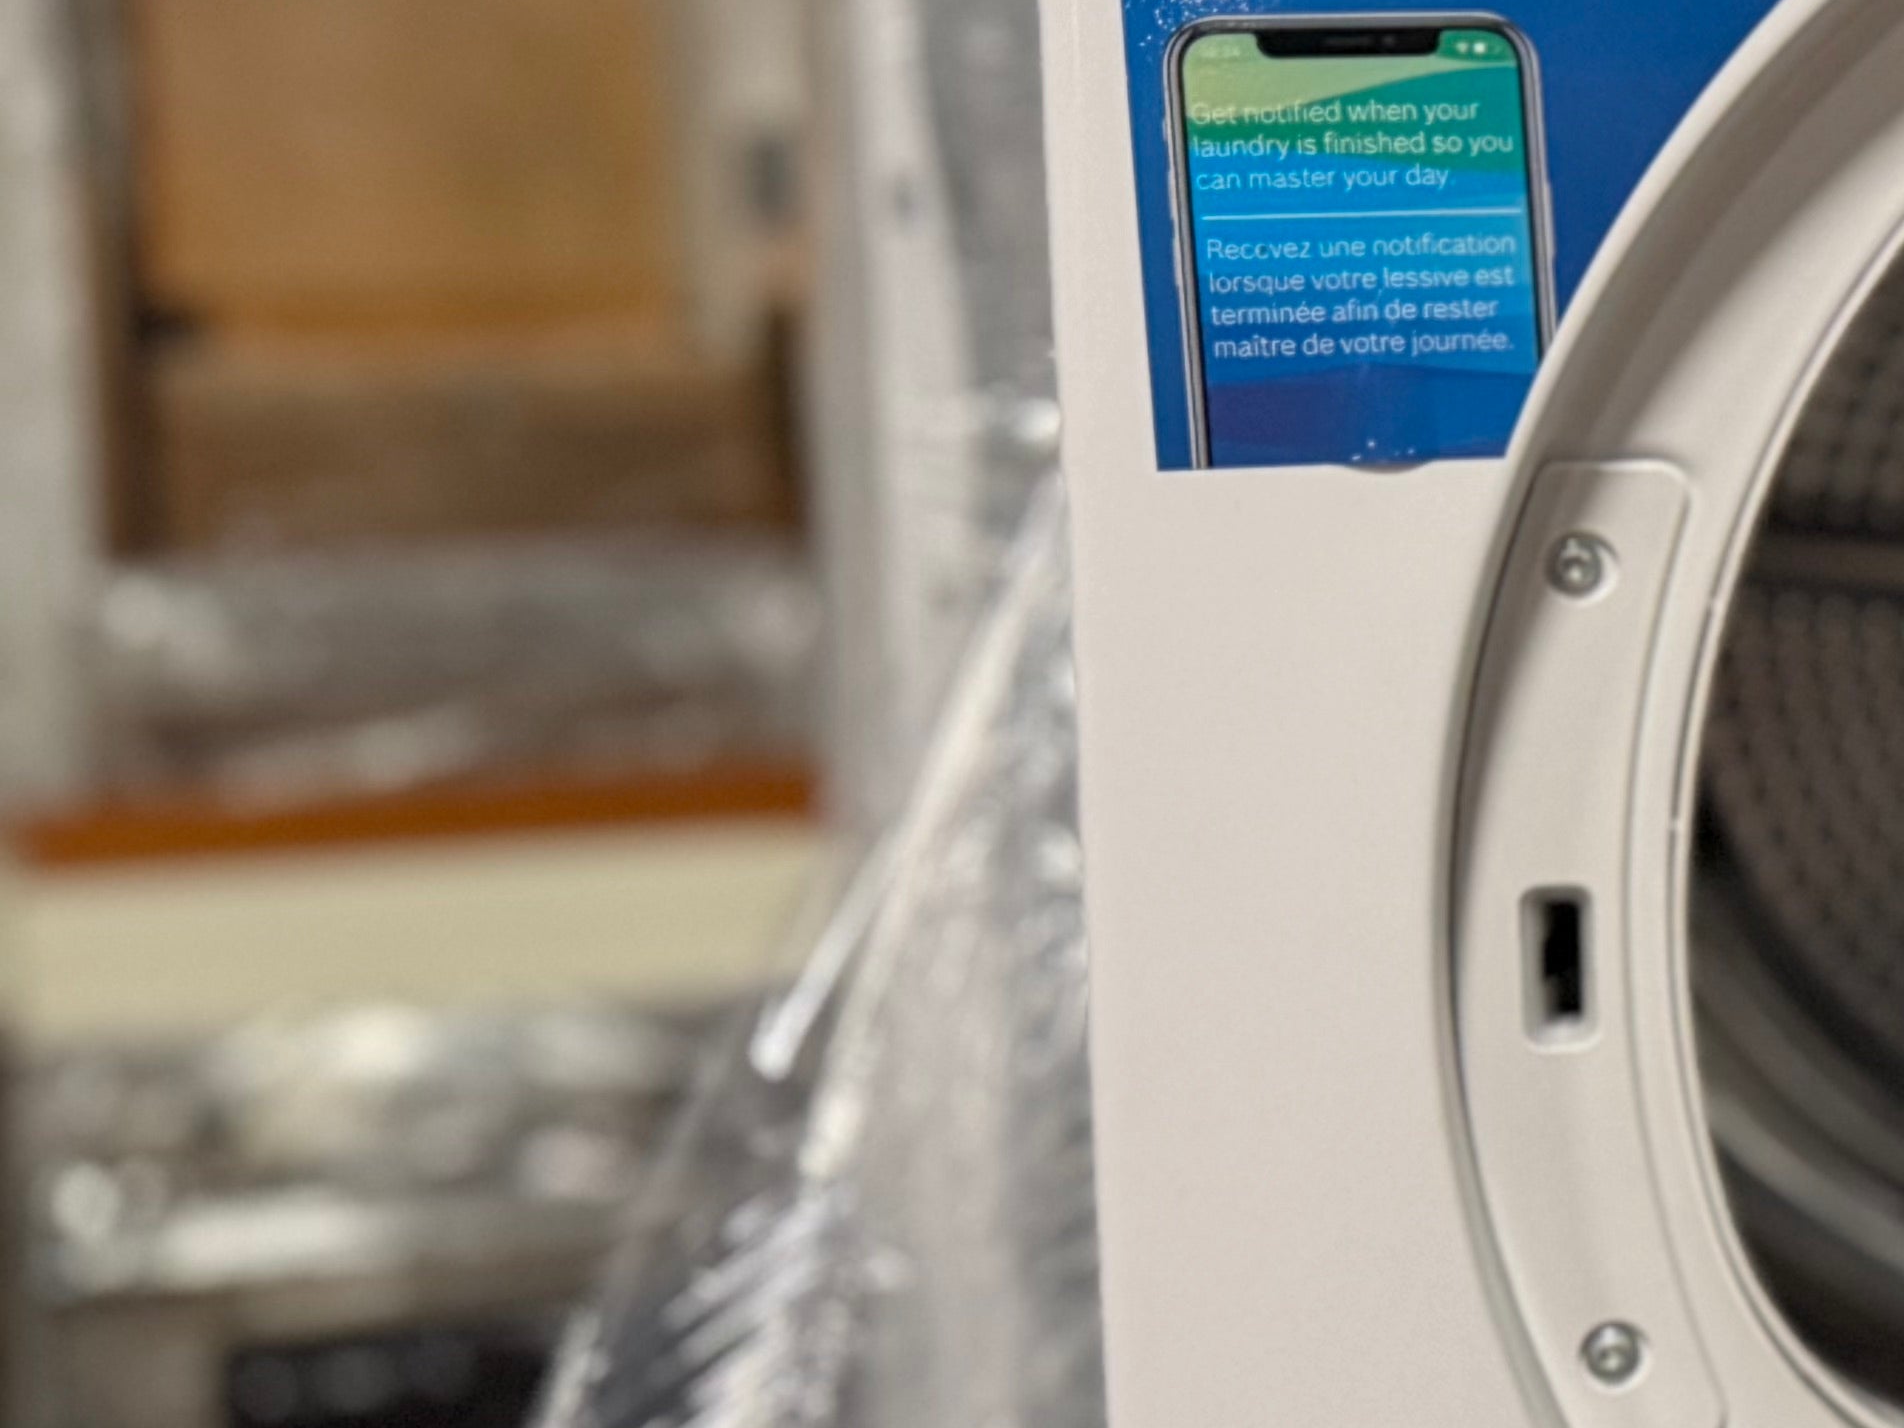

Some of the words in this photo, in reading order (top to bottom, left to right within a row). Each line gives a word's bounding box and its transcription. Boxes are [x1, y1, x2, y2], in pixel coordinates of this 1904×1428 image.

[1192, 103, 1238, 124] Get
[1243, 99, 1340, 123] notified
[1347, 100, 1417, 121] when
[1423, 102, 1479, 124] your
[1192, 135, 1289, 160] laundry
[1298, 134, 1317, 154] is
[1323, 131, 1425, 155] finished
[1432, 135, 1462, 153] so
[1468, 134, 1513, 156] you
[1196, 173, 1240, 190] can
[1249, 167, 1335, 188] master
[1342, 171, 1398, 191] your
[1319, 240, 1366, 258] une
[1372, 232, 1516, 256] notification
[1209, 274, 1304, 295] lorsque
[1311, 271, 1377, 291] votre
[1383, 267, 1468, 289] lessive
[1475, 266, 1515, 287] est
[1211, 303, 1326, 326] terminée
[1332, 300, 1378, 323] afin
[1384, 299, 1417, 321] de
[1423, 300, 1500, 320] rester
[1214, 335, 1296, 358] maître
[1303, 333, 1335, 356] de
[1341, 333, 1405, 353] votre
[1411, 329, 1515, 357] journée.
